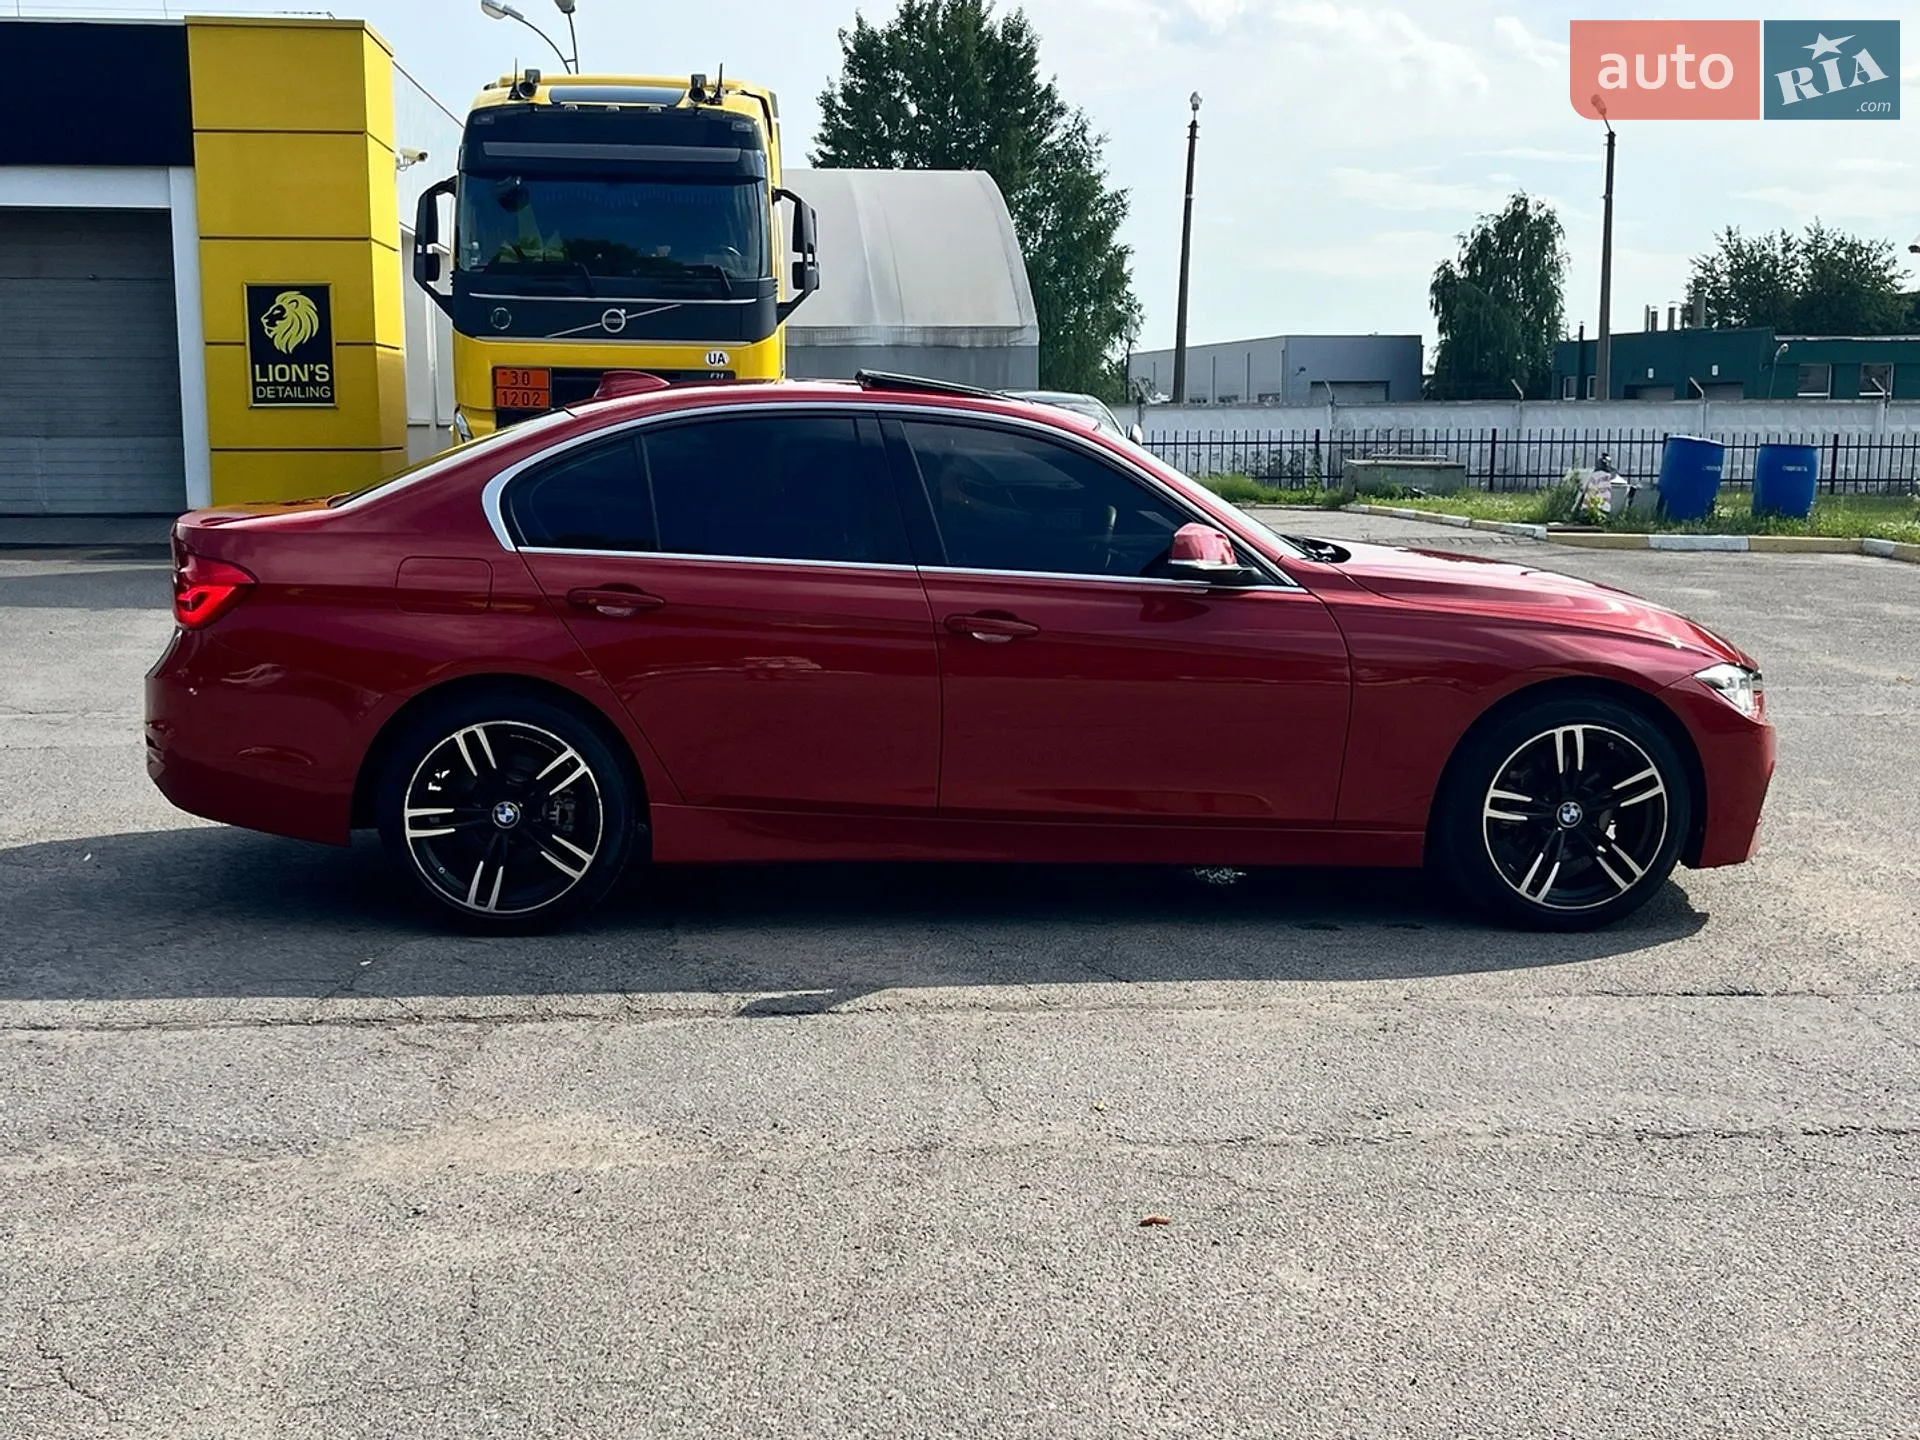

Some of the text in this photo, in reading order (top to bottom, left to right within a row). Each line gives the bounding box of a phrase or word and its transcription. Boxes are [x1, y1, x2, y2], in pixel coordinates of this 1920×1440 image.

[708, 352, 726, 365] UA
[254, 363, 330, 382] LION'S
[510, 370, 530, 386] 30
[255, 386, 331, 399] DETAILING
[501, 391, 541, 406] 1202
